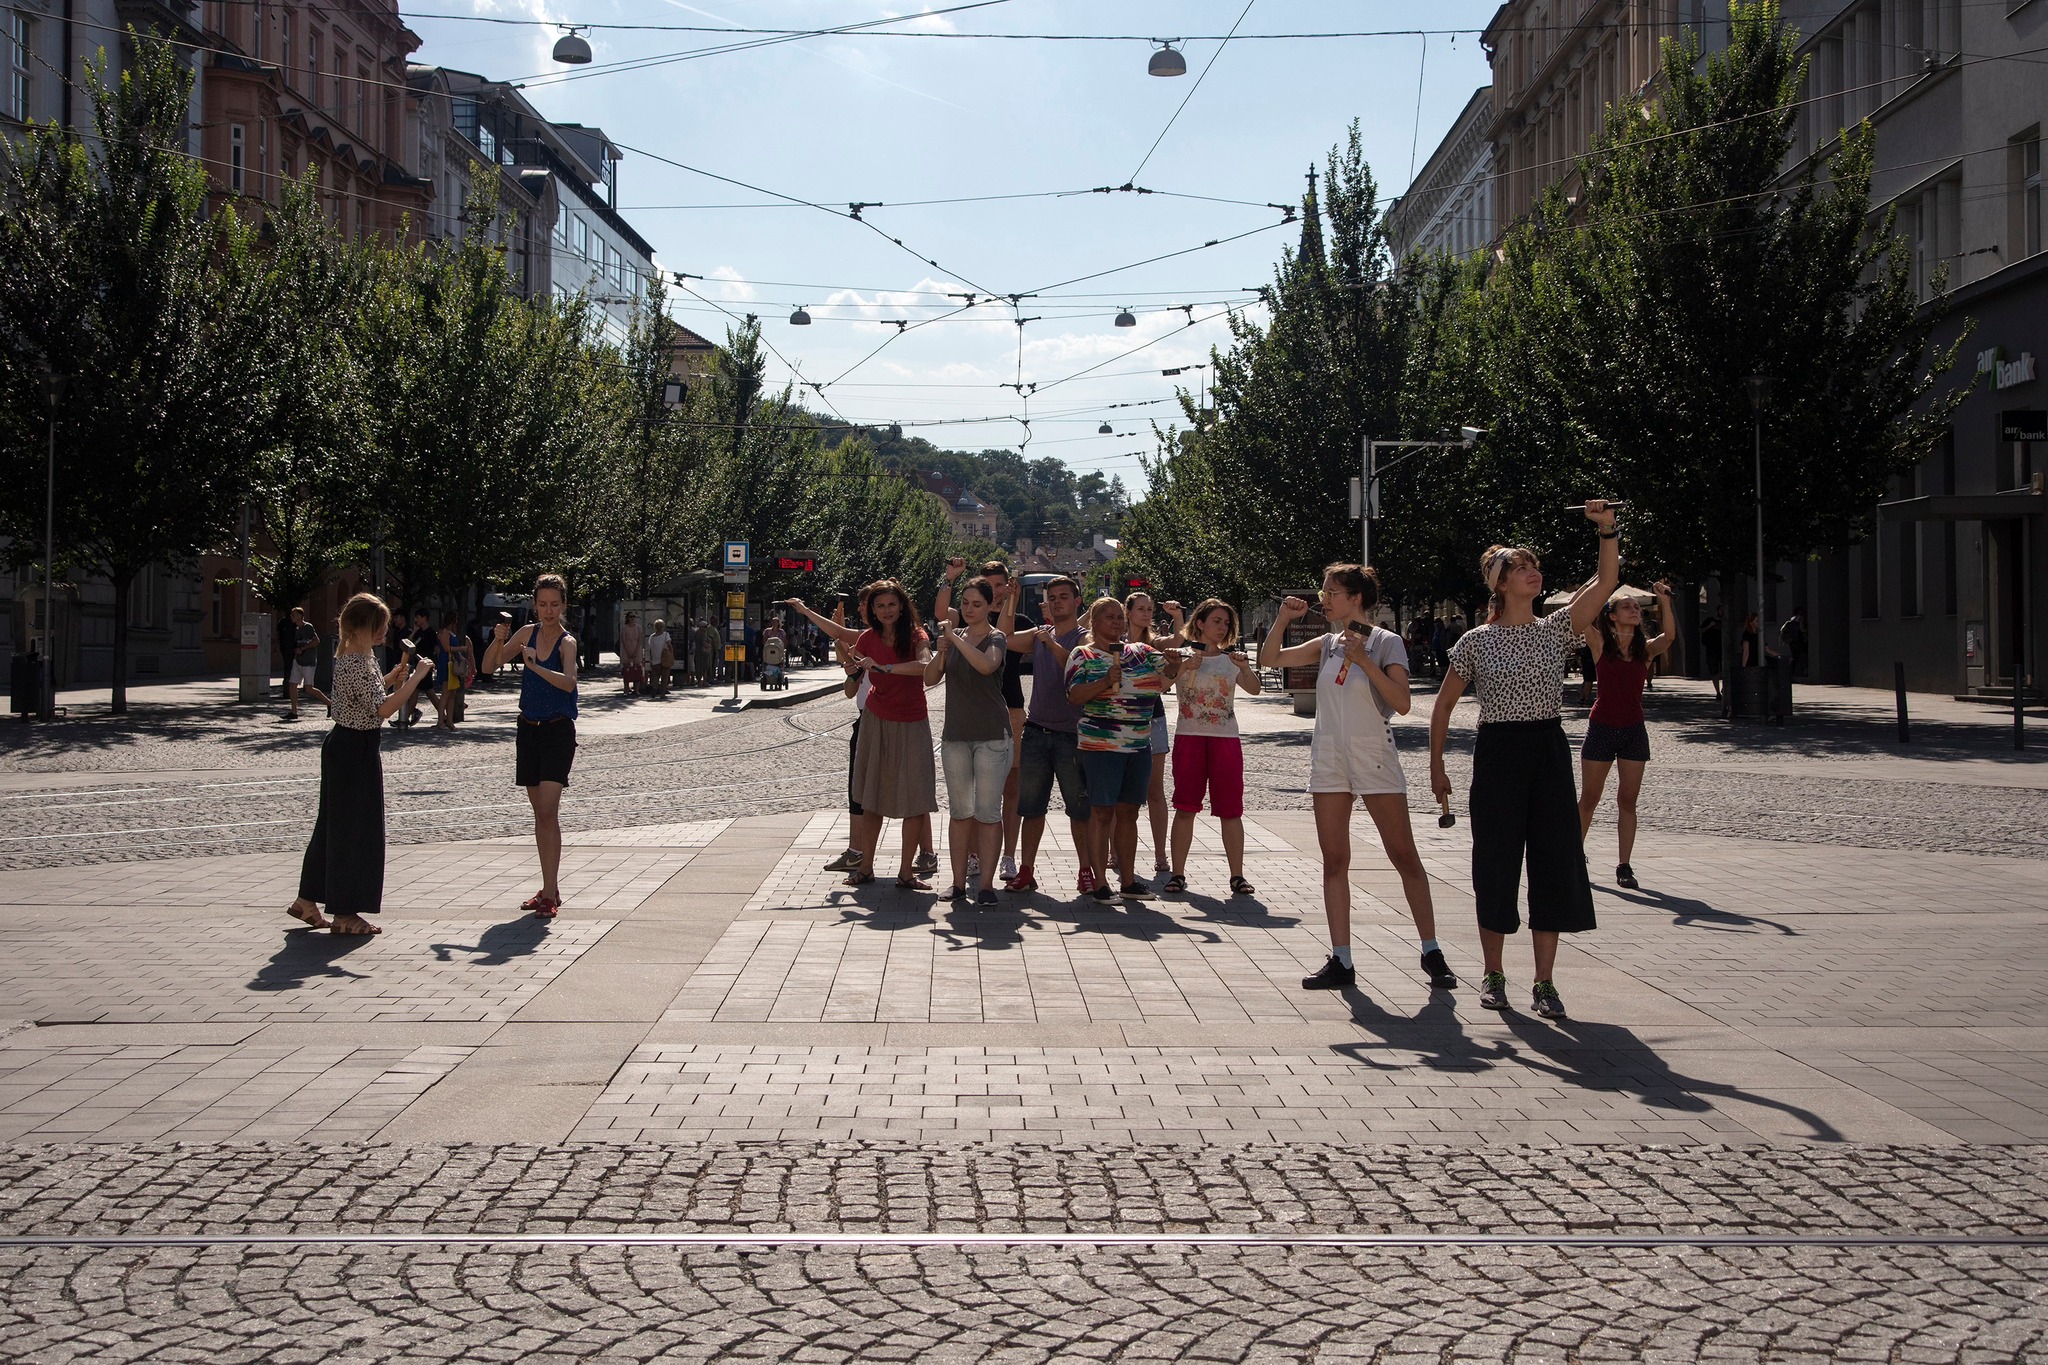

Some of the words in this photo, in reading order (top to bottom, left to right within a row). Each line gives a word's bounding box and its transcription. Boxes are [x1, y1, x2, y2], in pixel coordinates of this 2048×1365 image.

[1977, 348, 1995, 373] air
[1996, 352, 2035, 389] bank
[2005, 426, 2018, 434] air
[2020, 431, 2046, 440] bank
